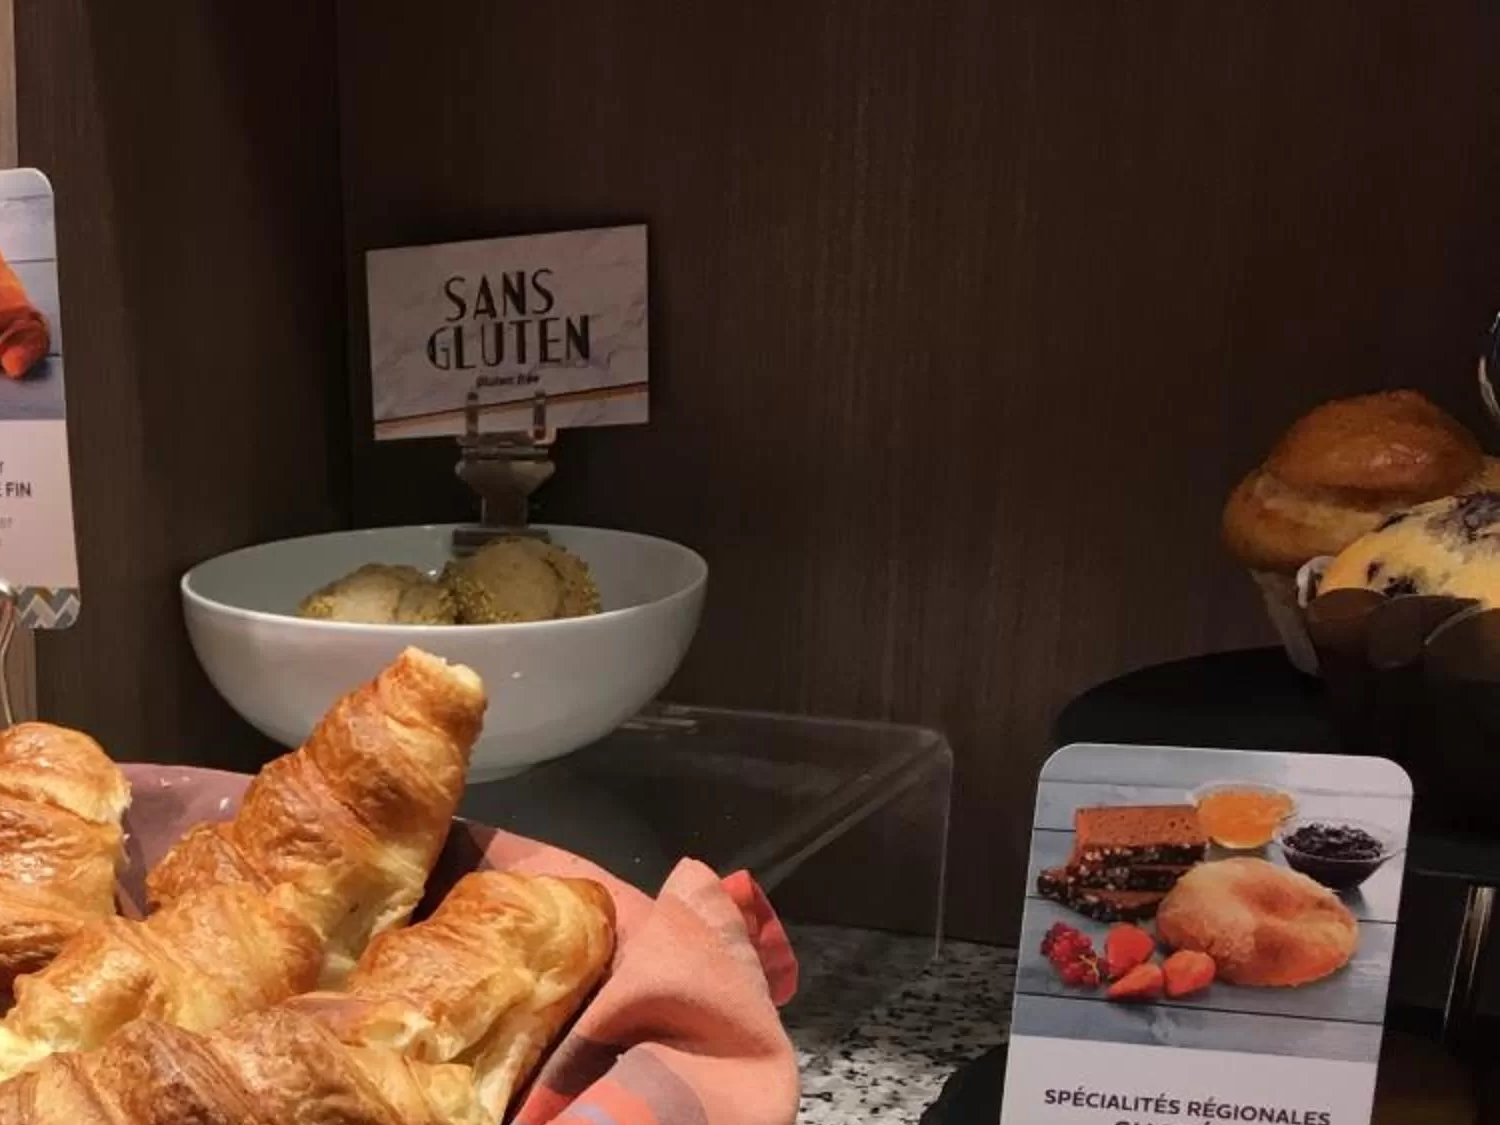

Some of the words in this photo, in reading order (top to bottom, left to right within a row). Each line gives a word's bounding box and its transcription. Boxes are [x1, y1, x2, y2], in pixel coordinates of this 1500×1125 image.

[444, 268, 554, 321] SANS
[427, 315, 591, 370] GLUTEN
[5, 481, 32, 498] FIN
[1044, 1086, 1181, 1115] SPÉCIALITÉS
